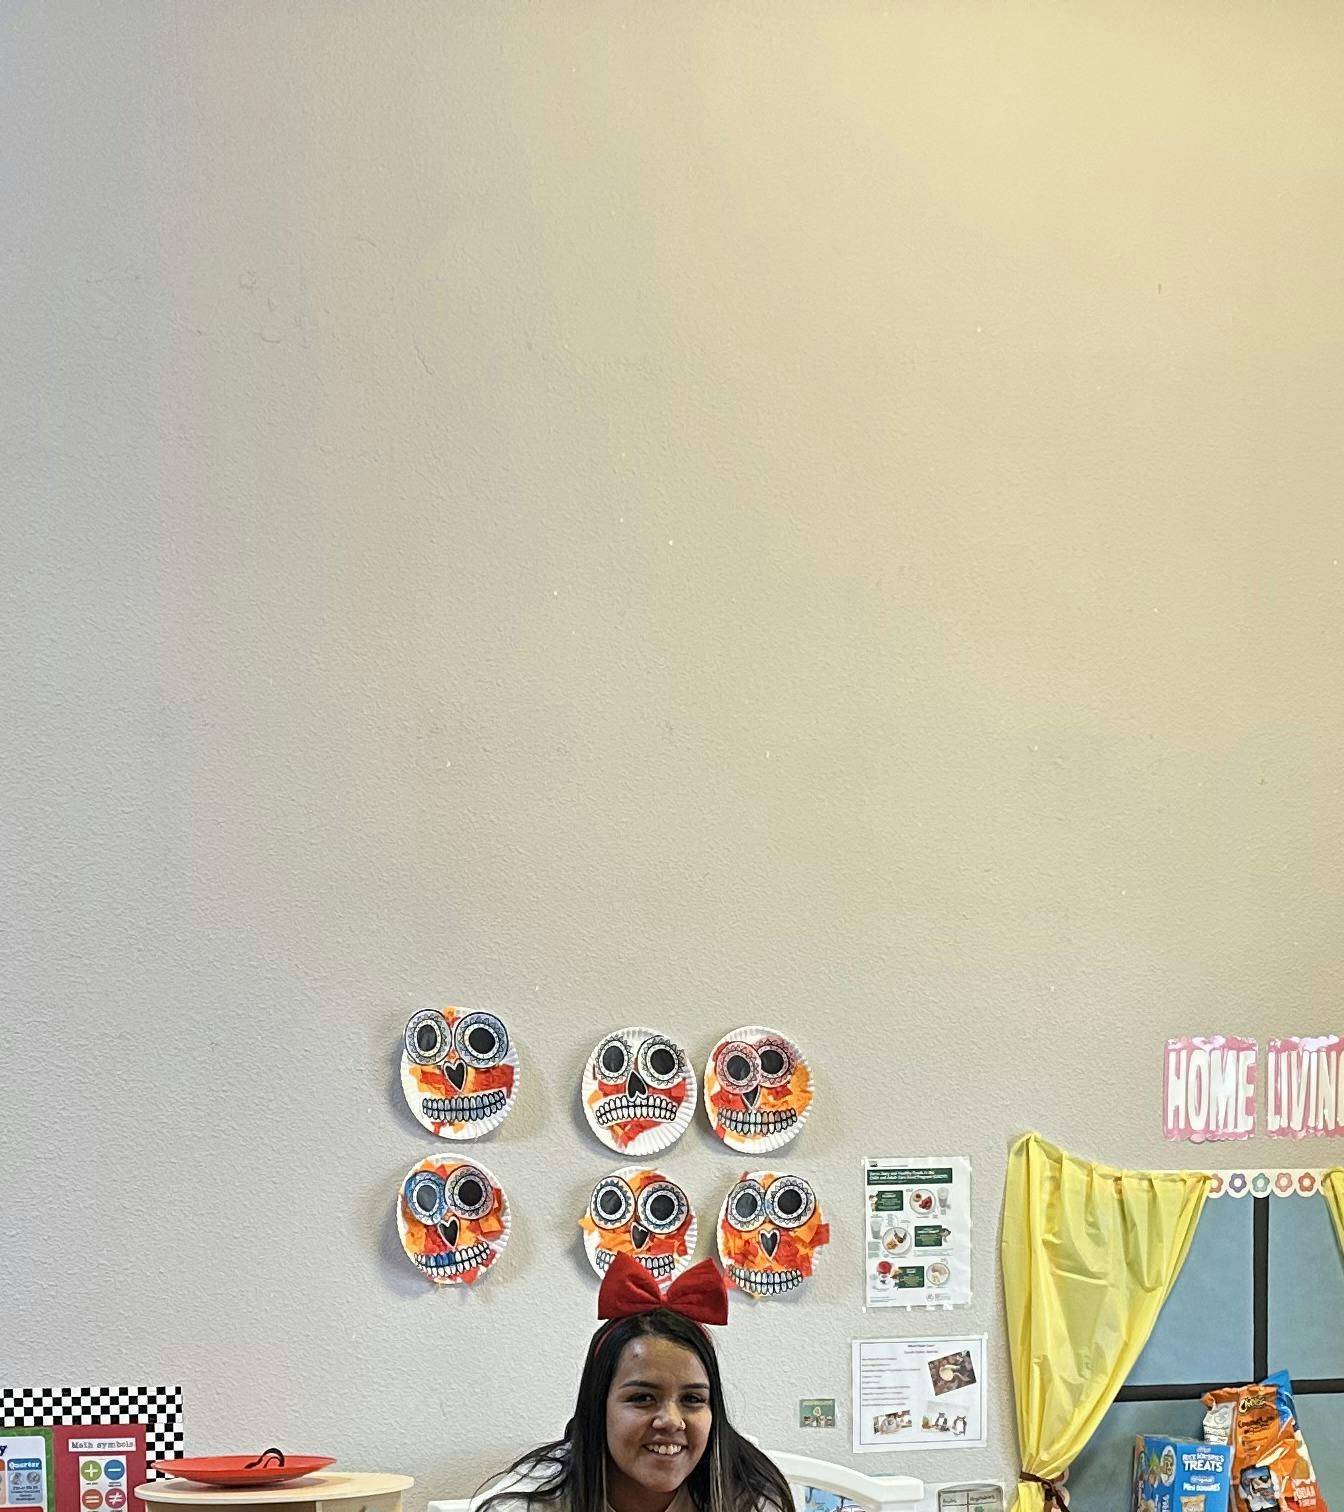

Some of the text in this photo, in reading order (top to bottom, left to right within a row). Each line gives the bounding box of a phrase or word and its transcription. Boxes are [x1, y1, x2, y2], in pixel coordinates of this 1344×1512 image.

[1167, 1049, 1256, 1133] HOME
[71, 1439, 134, 1450] Math symbols
[1184, 1460, 1223, 1472] TREATS
